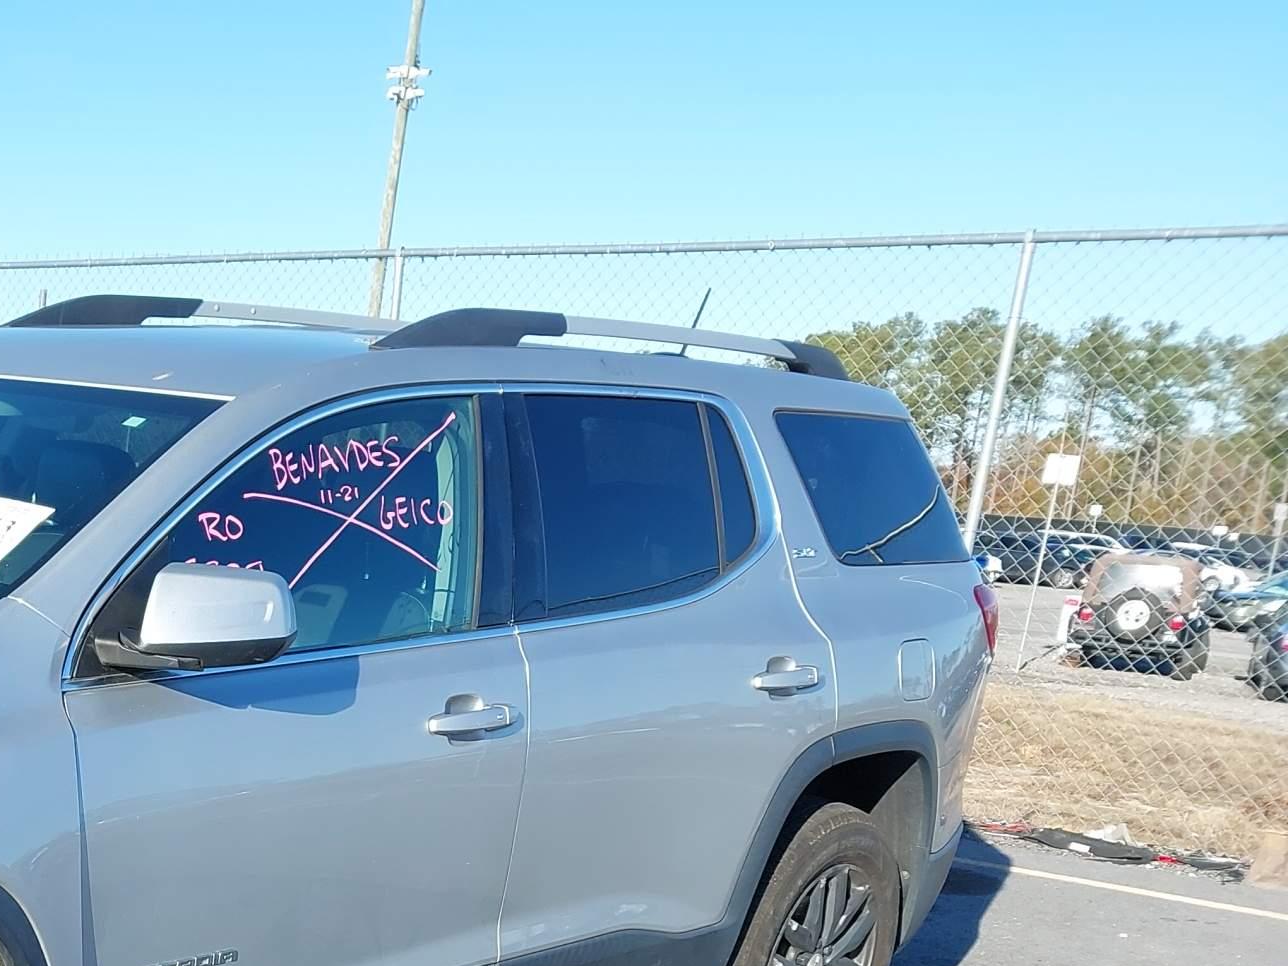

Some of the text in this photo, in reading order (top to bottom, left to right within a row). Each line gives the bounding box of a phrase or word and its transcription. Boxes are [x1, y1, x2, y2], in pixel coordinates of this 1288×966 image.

[319, 484, 360, 505] 11-21
[197, 511, 244, 542] RO
[379, 495, 454, 531] GEICO
